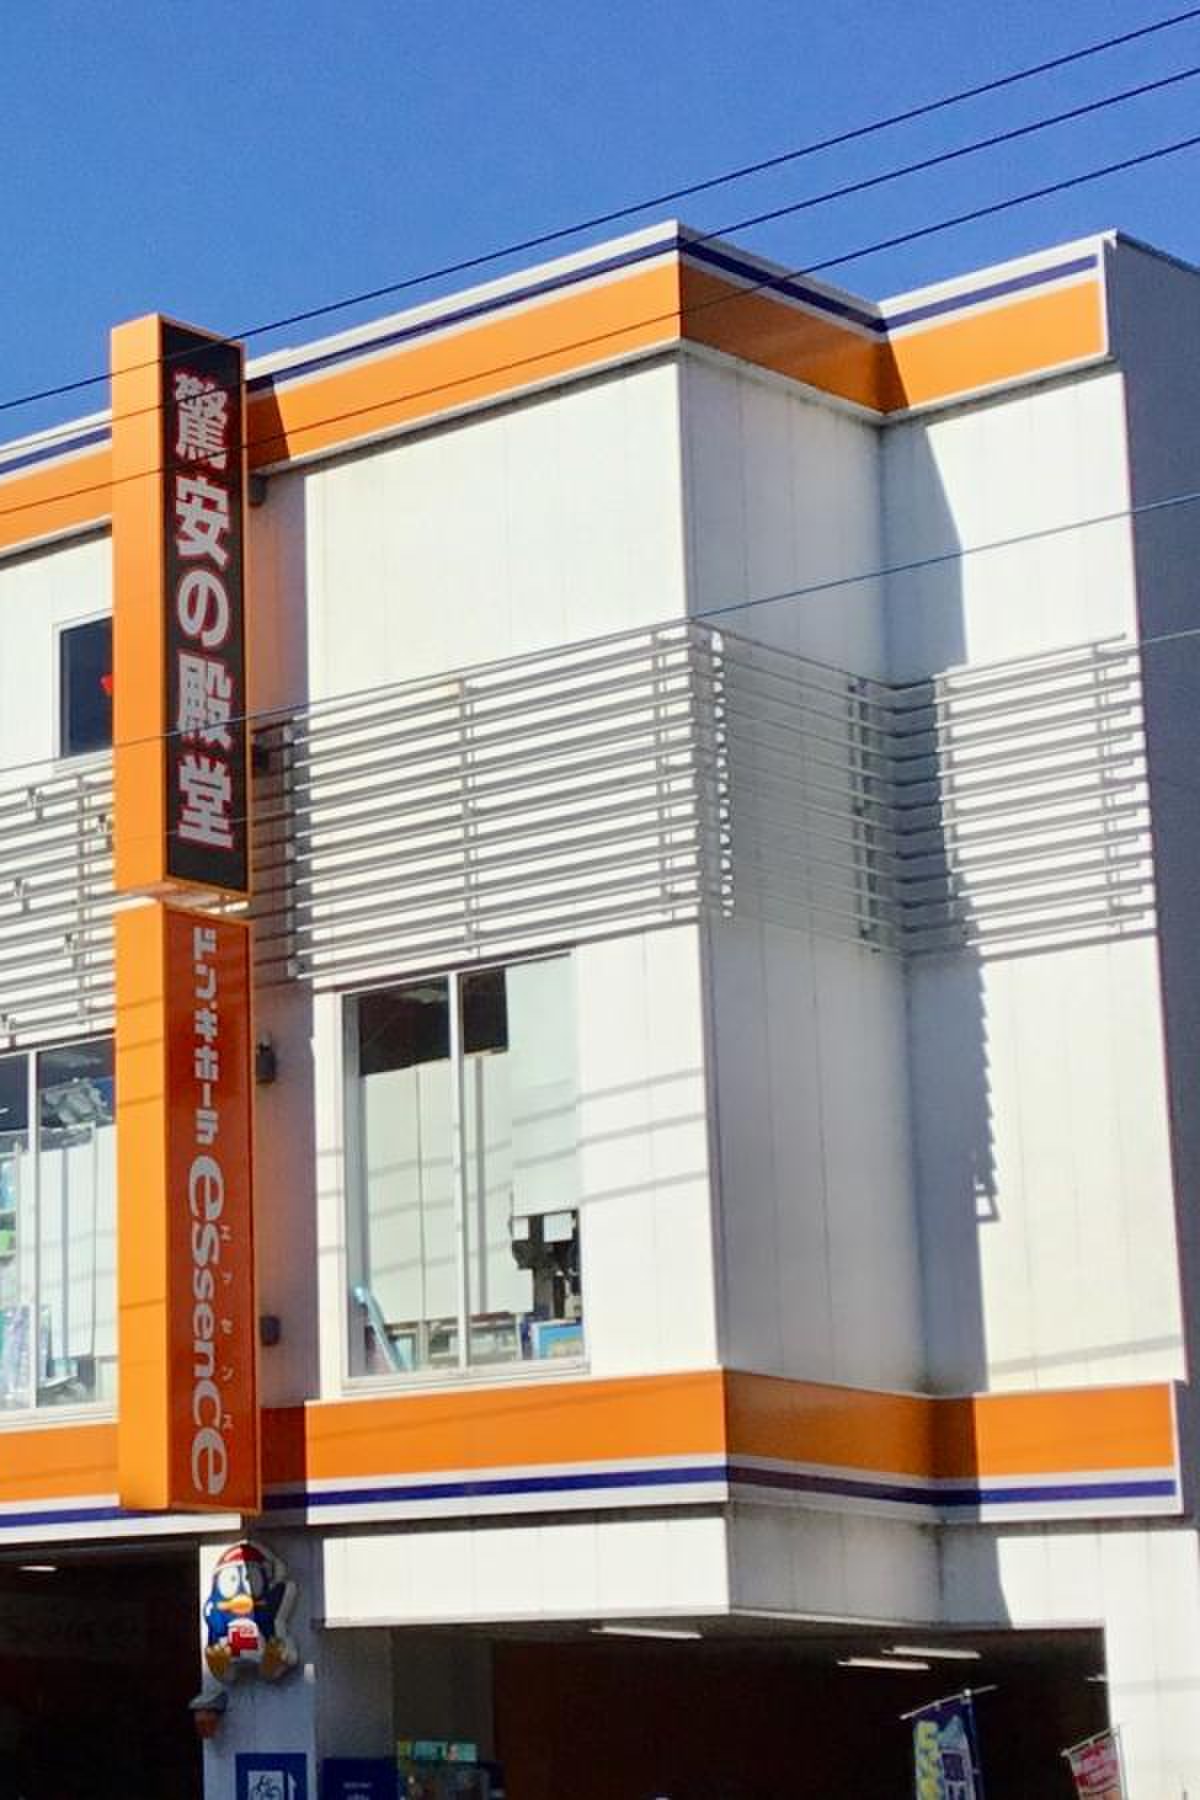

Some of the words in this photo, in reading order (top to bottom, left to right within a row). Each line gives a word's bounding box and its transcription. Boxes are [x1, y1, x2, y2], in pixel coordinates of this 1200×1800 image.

[174, 371, 234, 850] 驚安の殿堂
[187, 1154, 228, 1496] essence
